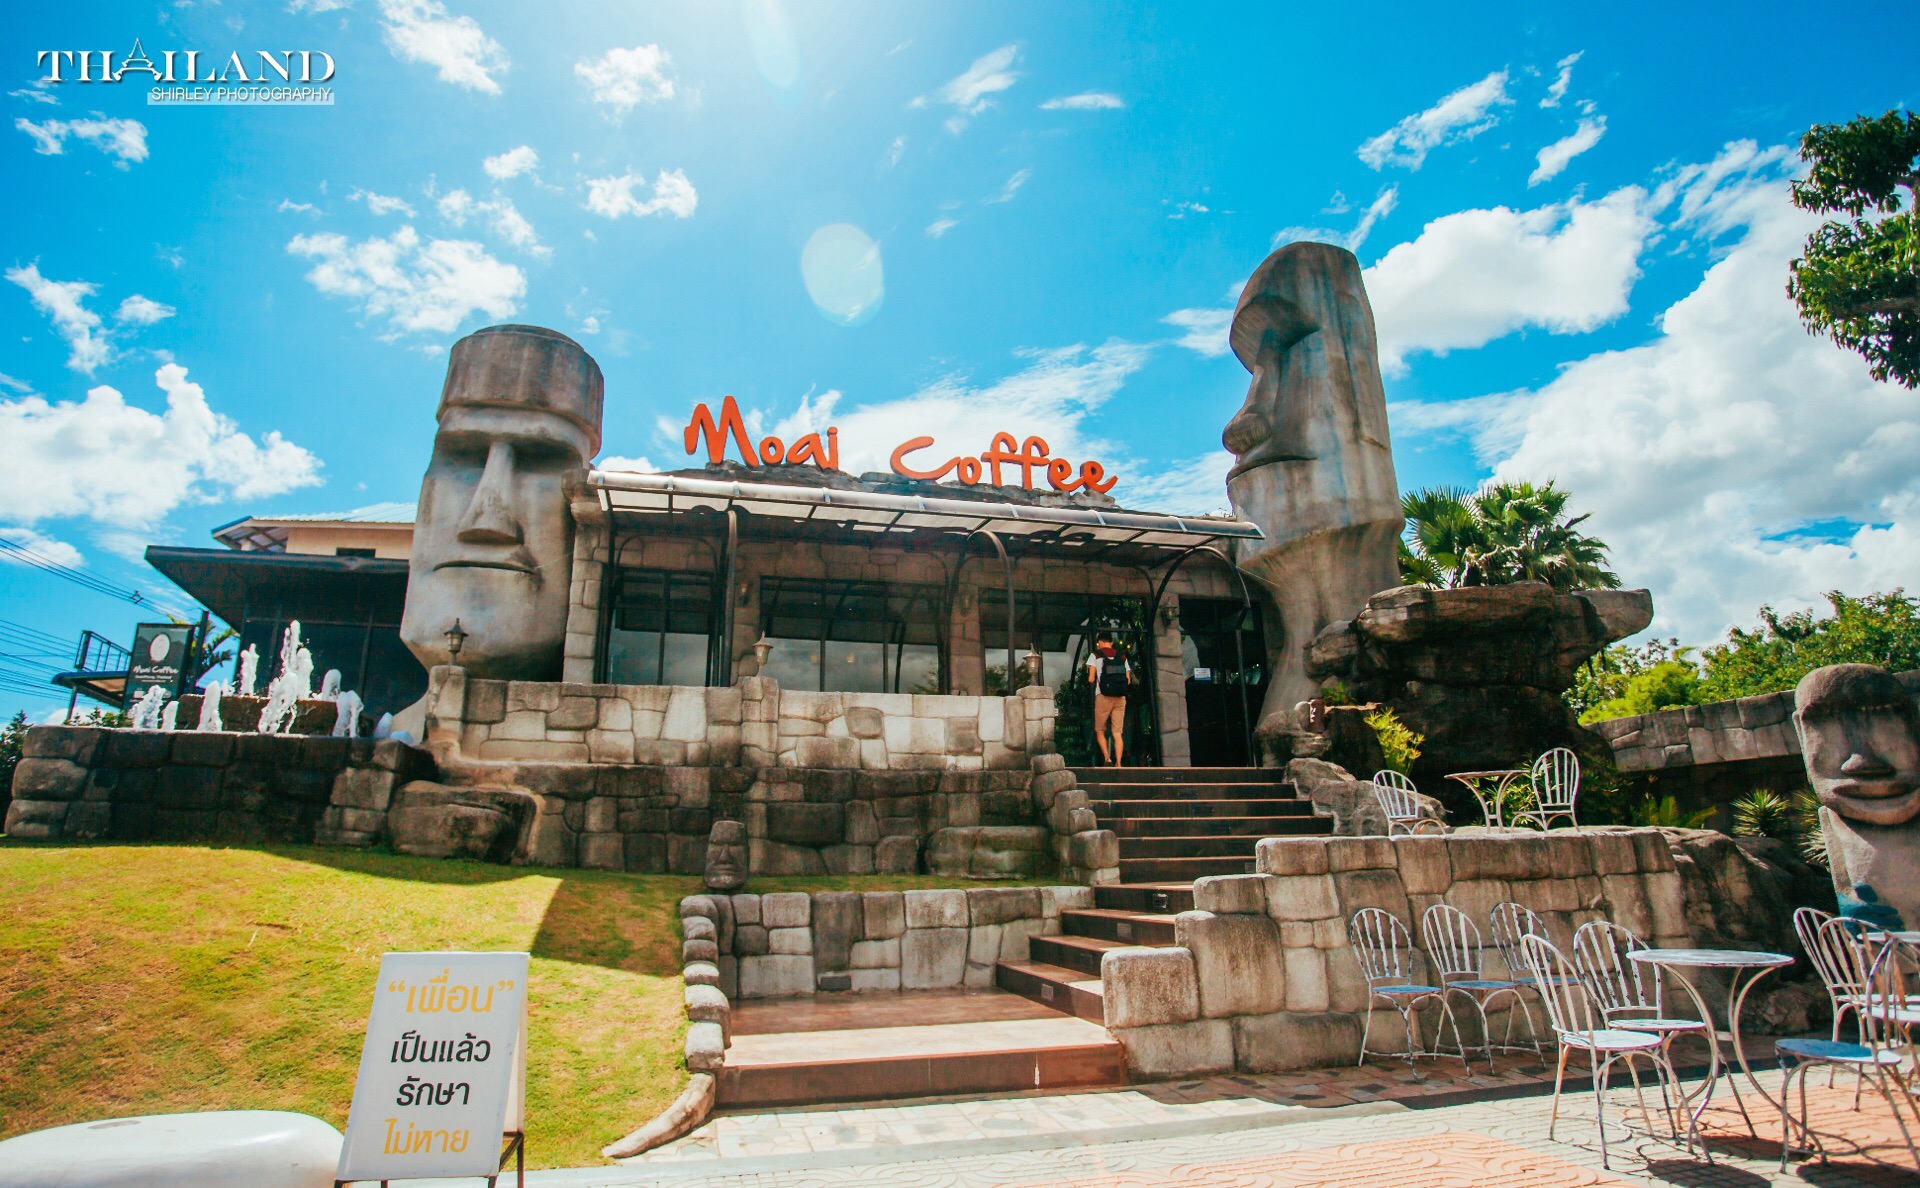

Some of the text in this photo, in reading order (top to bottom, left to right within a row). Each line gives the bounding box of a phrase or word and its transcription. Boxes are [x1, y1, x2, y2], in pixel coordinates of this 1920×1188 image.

[684, 395, 1118, 494] Moai Coffee
[390, 1029, 491, 1063] เป็นแล้ว
[396, 1075, 470, 1106] รักษา
[384, 1117, 469, 1155] ไม่หาย
